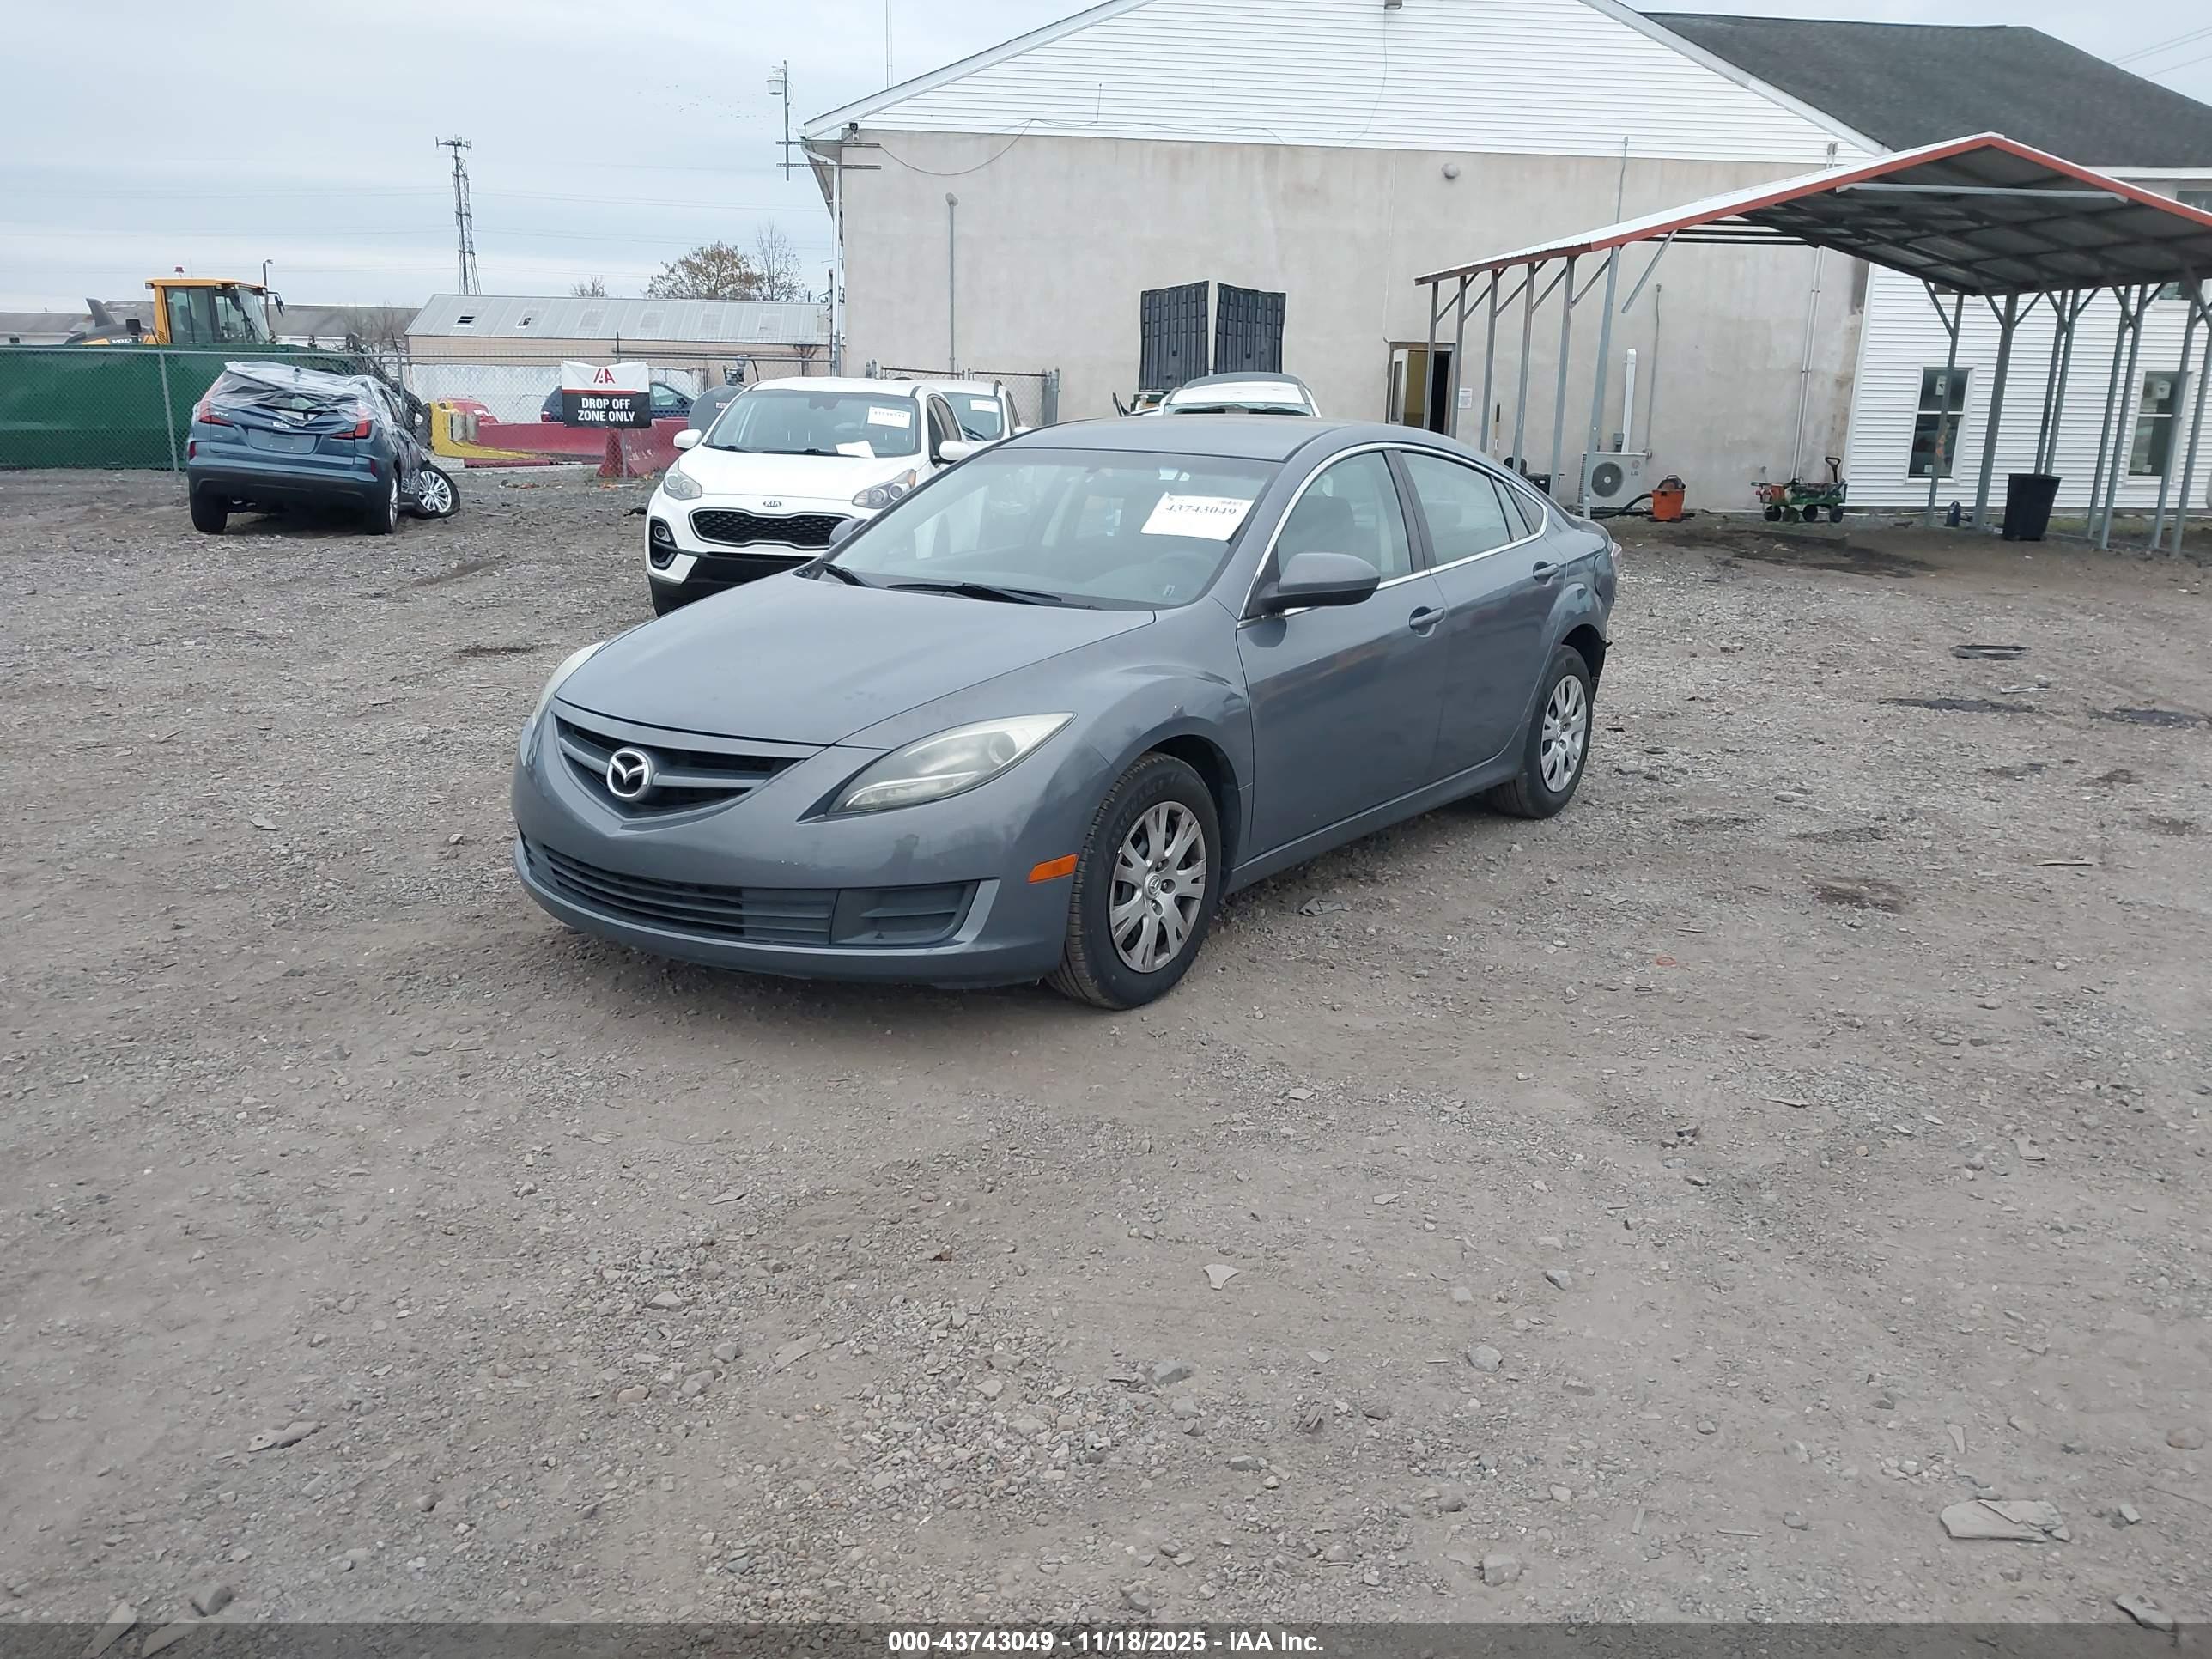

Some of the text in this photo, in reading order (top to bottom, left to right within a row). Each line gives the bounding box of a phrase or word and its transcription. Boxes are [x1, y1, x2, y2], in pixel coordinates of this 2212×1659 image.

[581, 398, 631, 410] DROP OFF
[578, 410, 635, 422] ZONE ONLY
[1166, 504, 1237, 515] 43743049
